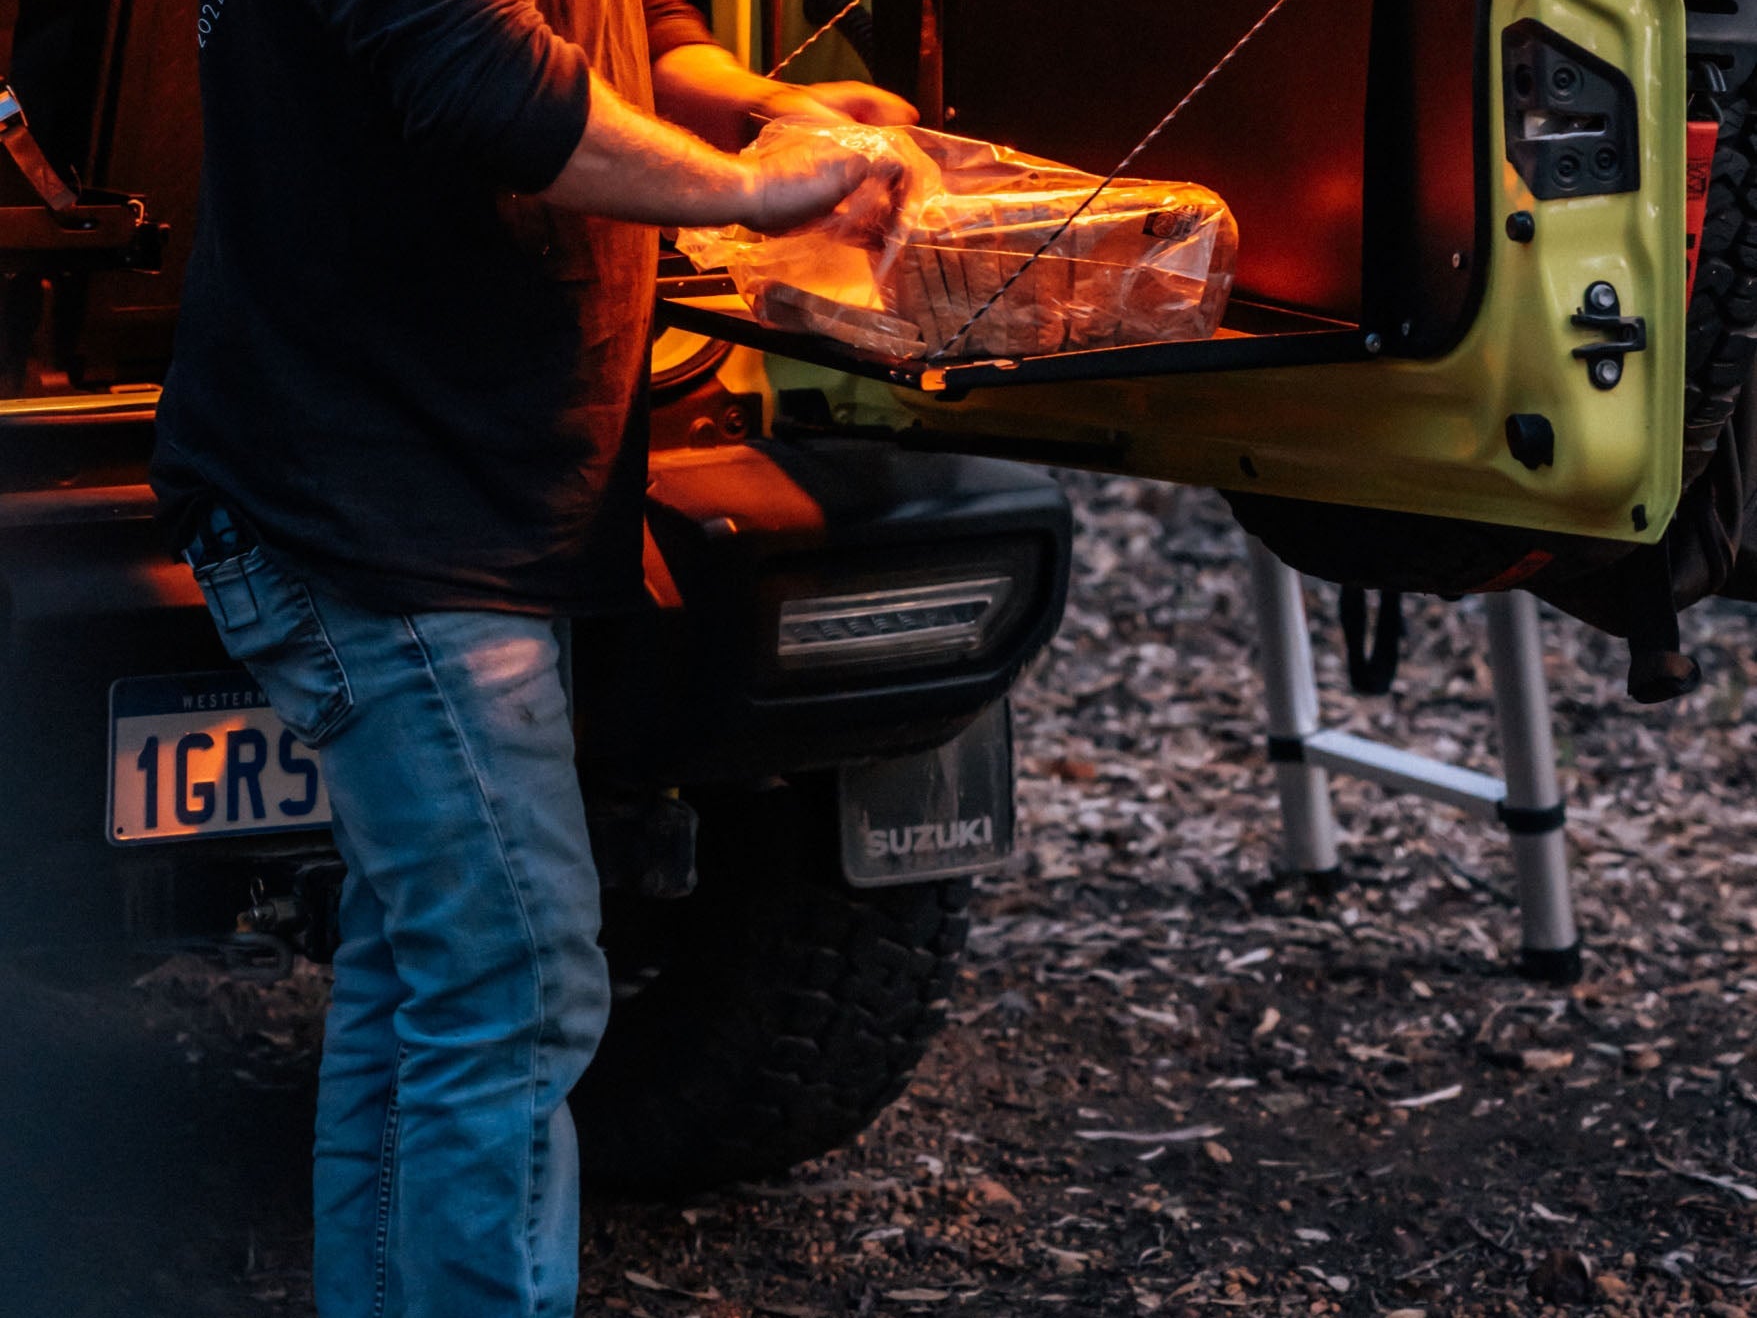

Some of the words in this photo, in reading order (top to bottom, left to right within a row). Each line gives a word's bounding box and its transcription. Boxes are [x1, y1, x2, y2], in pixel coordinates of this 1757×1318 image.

[182, 691, 267, 709] WESTERN
[137, 728, 319, 831] 1GRS
[866, 814, 993, 859] SUZUKI
